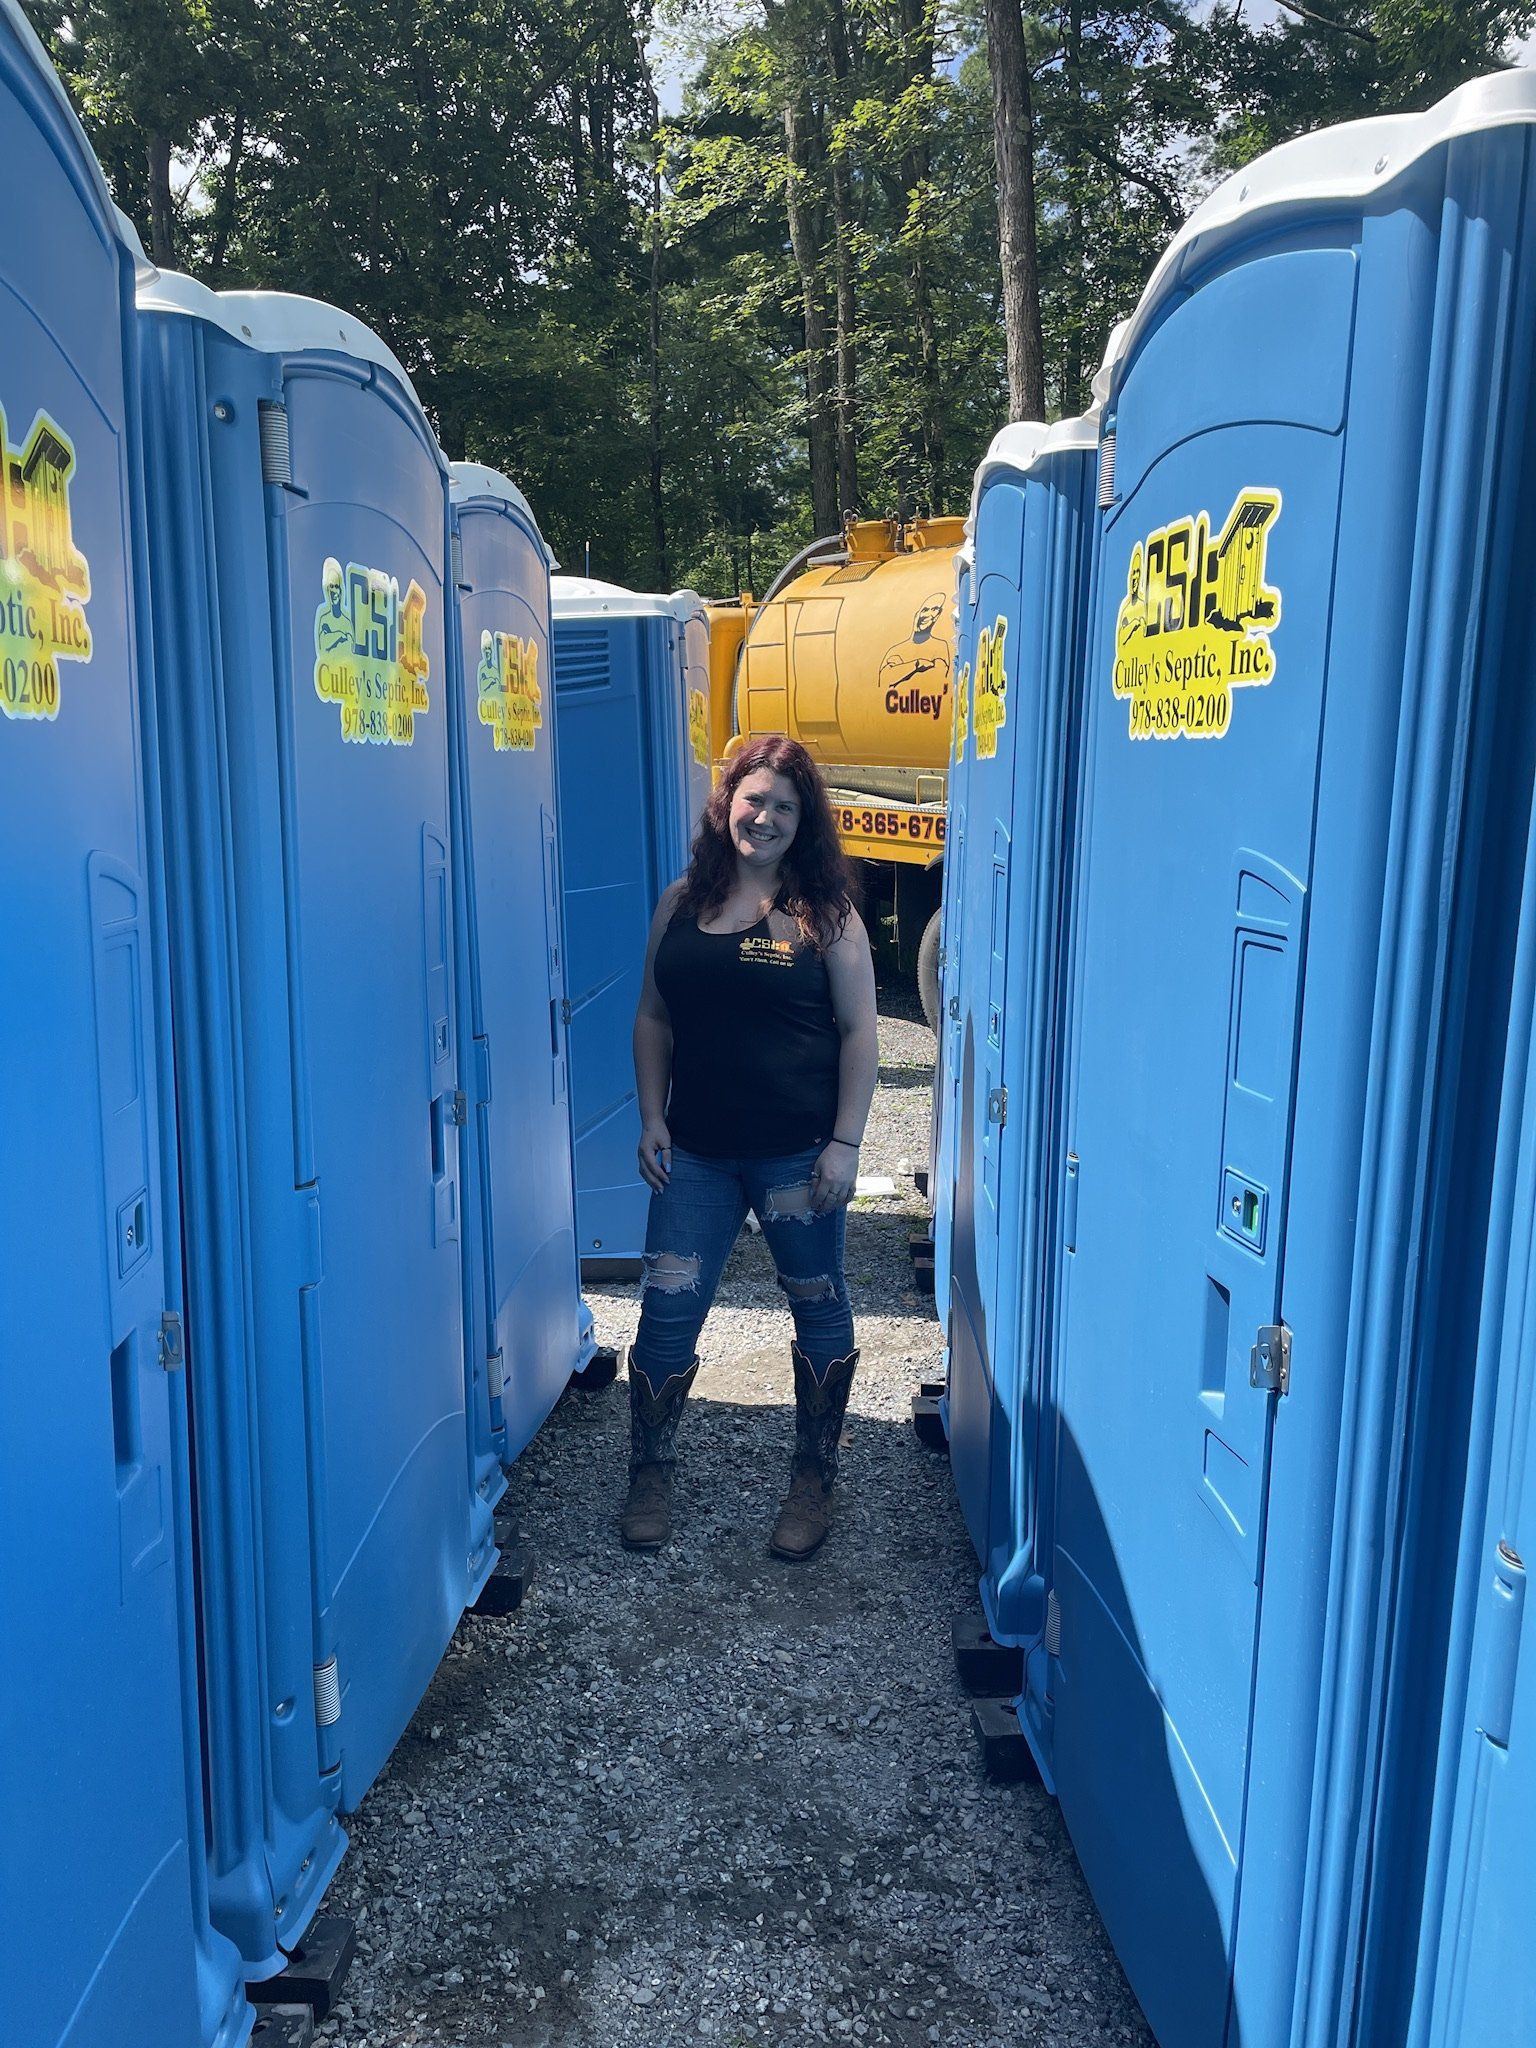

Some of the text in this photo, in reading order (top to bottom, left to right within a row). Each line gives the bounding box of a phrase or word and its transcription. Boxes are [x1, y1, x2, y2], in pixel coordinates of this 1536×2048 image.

[50, 600, 88, 649] Inc.
[0, 657, 55, 706] 0200
[318, 663, 428, 708] Culley's Septic, Inc.
[1115, 639, 1270, 694] Culley's Septic, Inc.
[344, 707, 413, 738] 978-838-0200
[885, 683, 953, 721] Culley'
[1132, 692, 1227, 730] 978-838-0200
